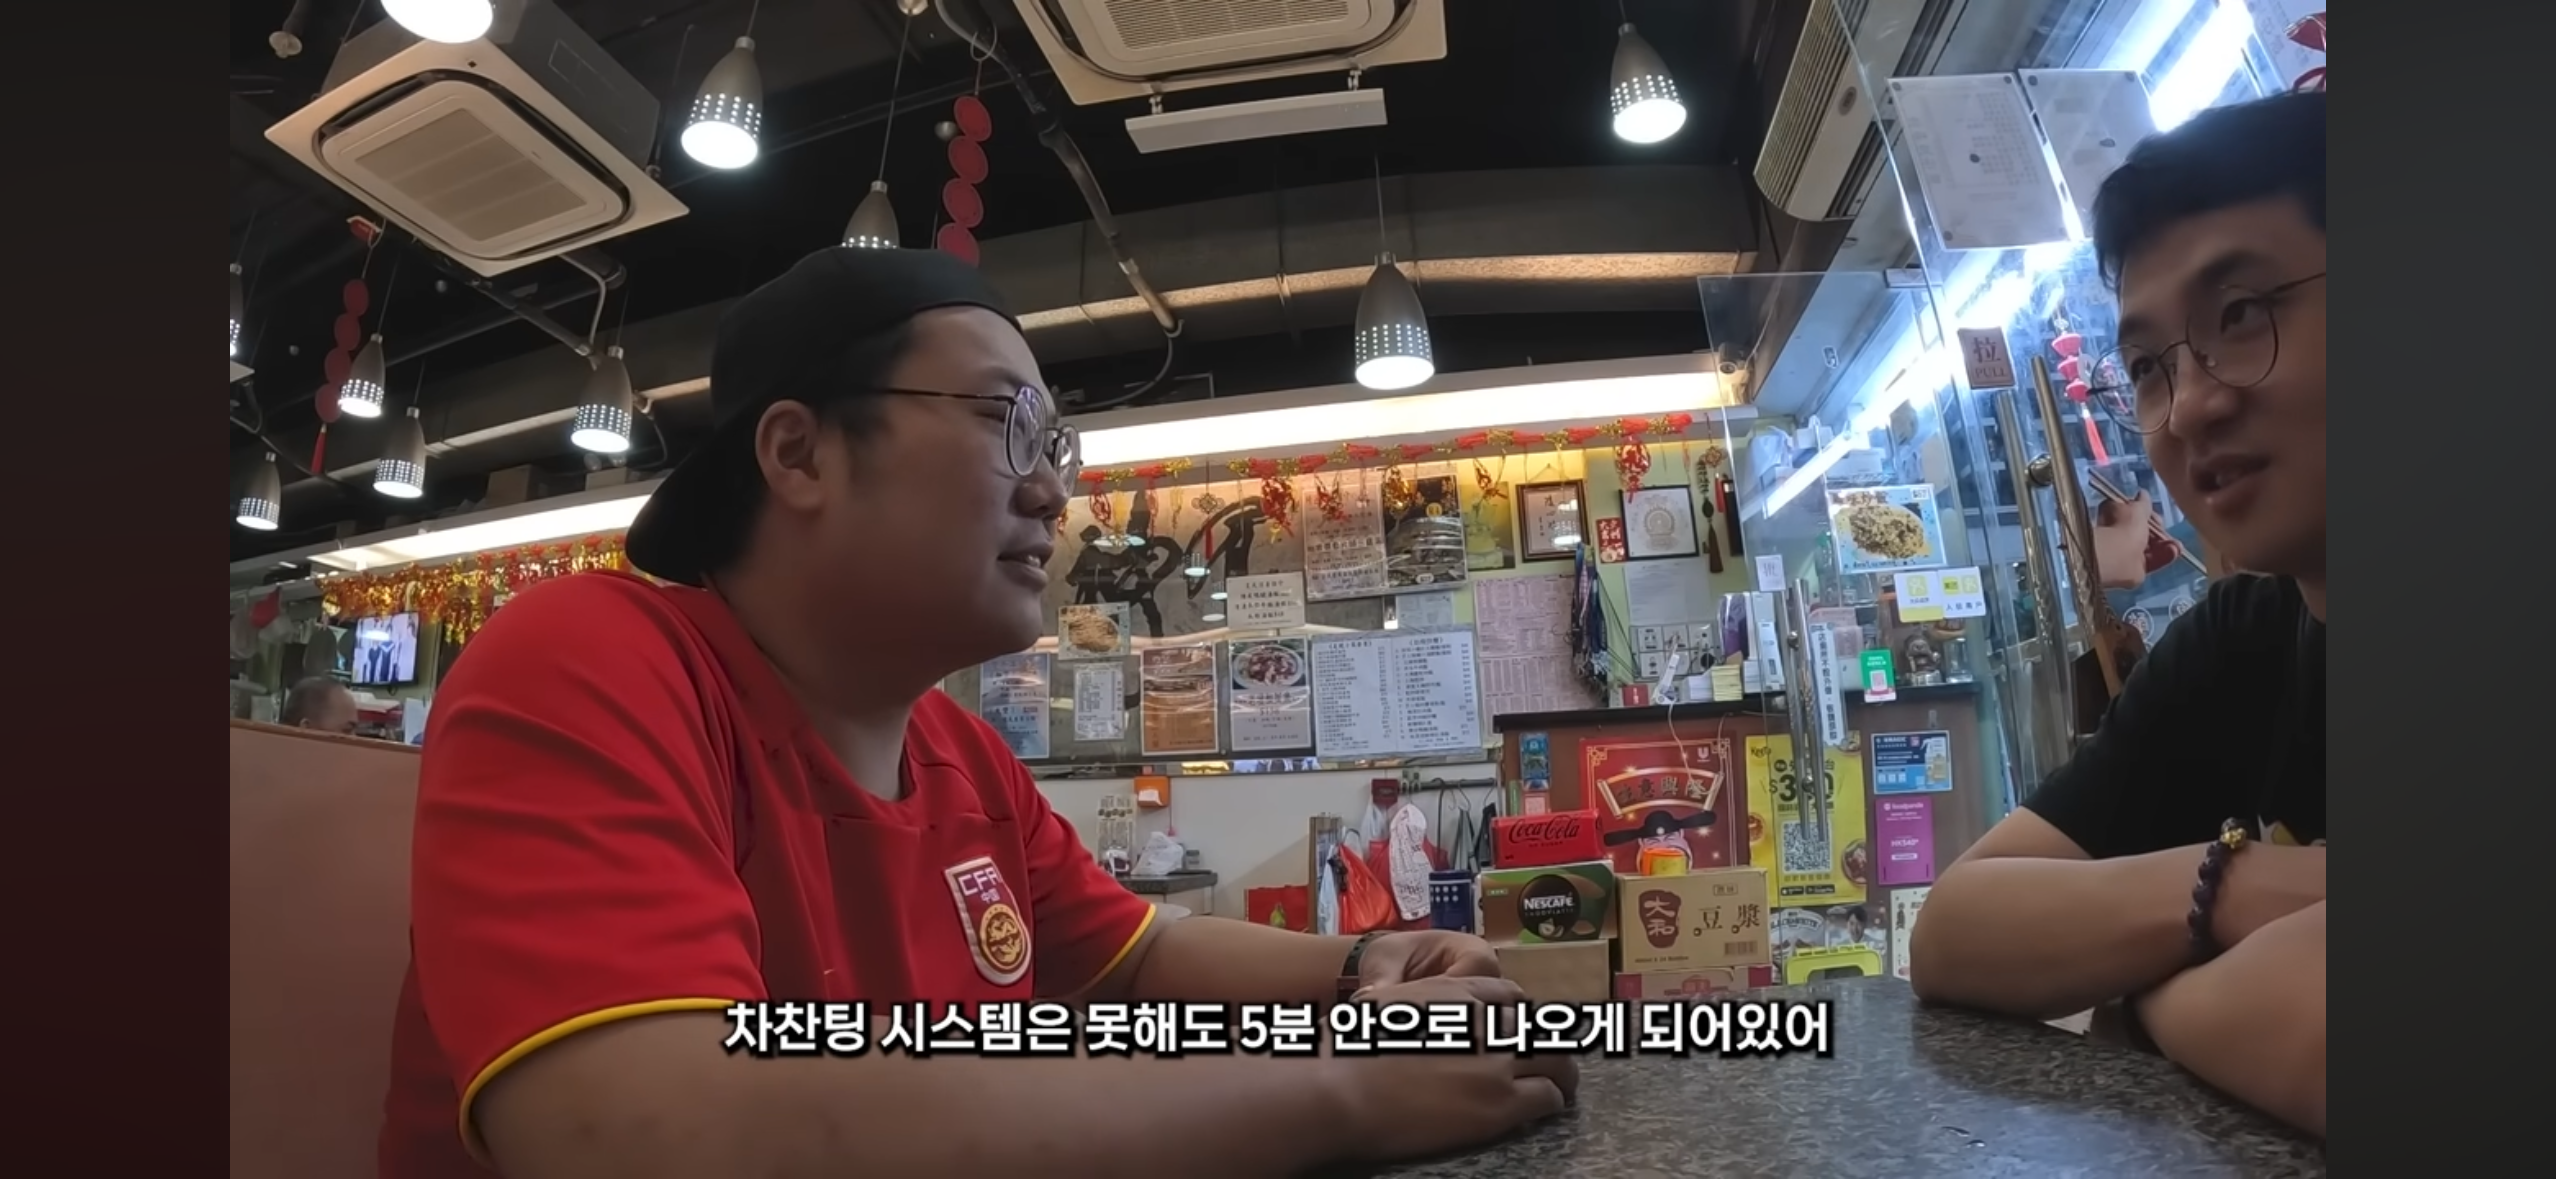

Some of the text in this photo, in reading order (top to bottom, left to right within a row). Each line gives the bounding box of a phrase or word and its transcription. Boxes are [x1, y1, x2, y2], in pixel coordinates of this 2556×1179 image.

[1971, 336, 2002, 364] 拉
[1974, 366, 2008, 379] PULL
[1508, 815, 1580, 844] Coca-Cola
[1643, 895, 1676, 937] 大和
[1694, 903, 1761, 937] 豆漿
